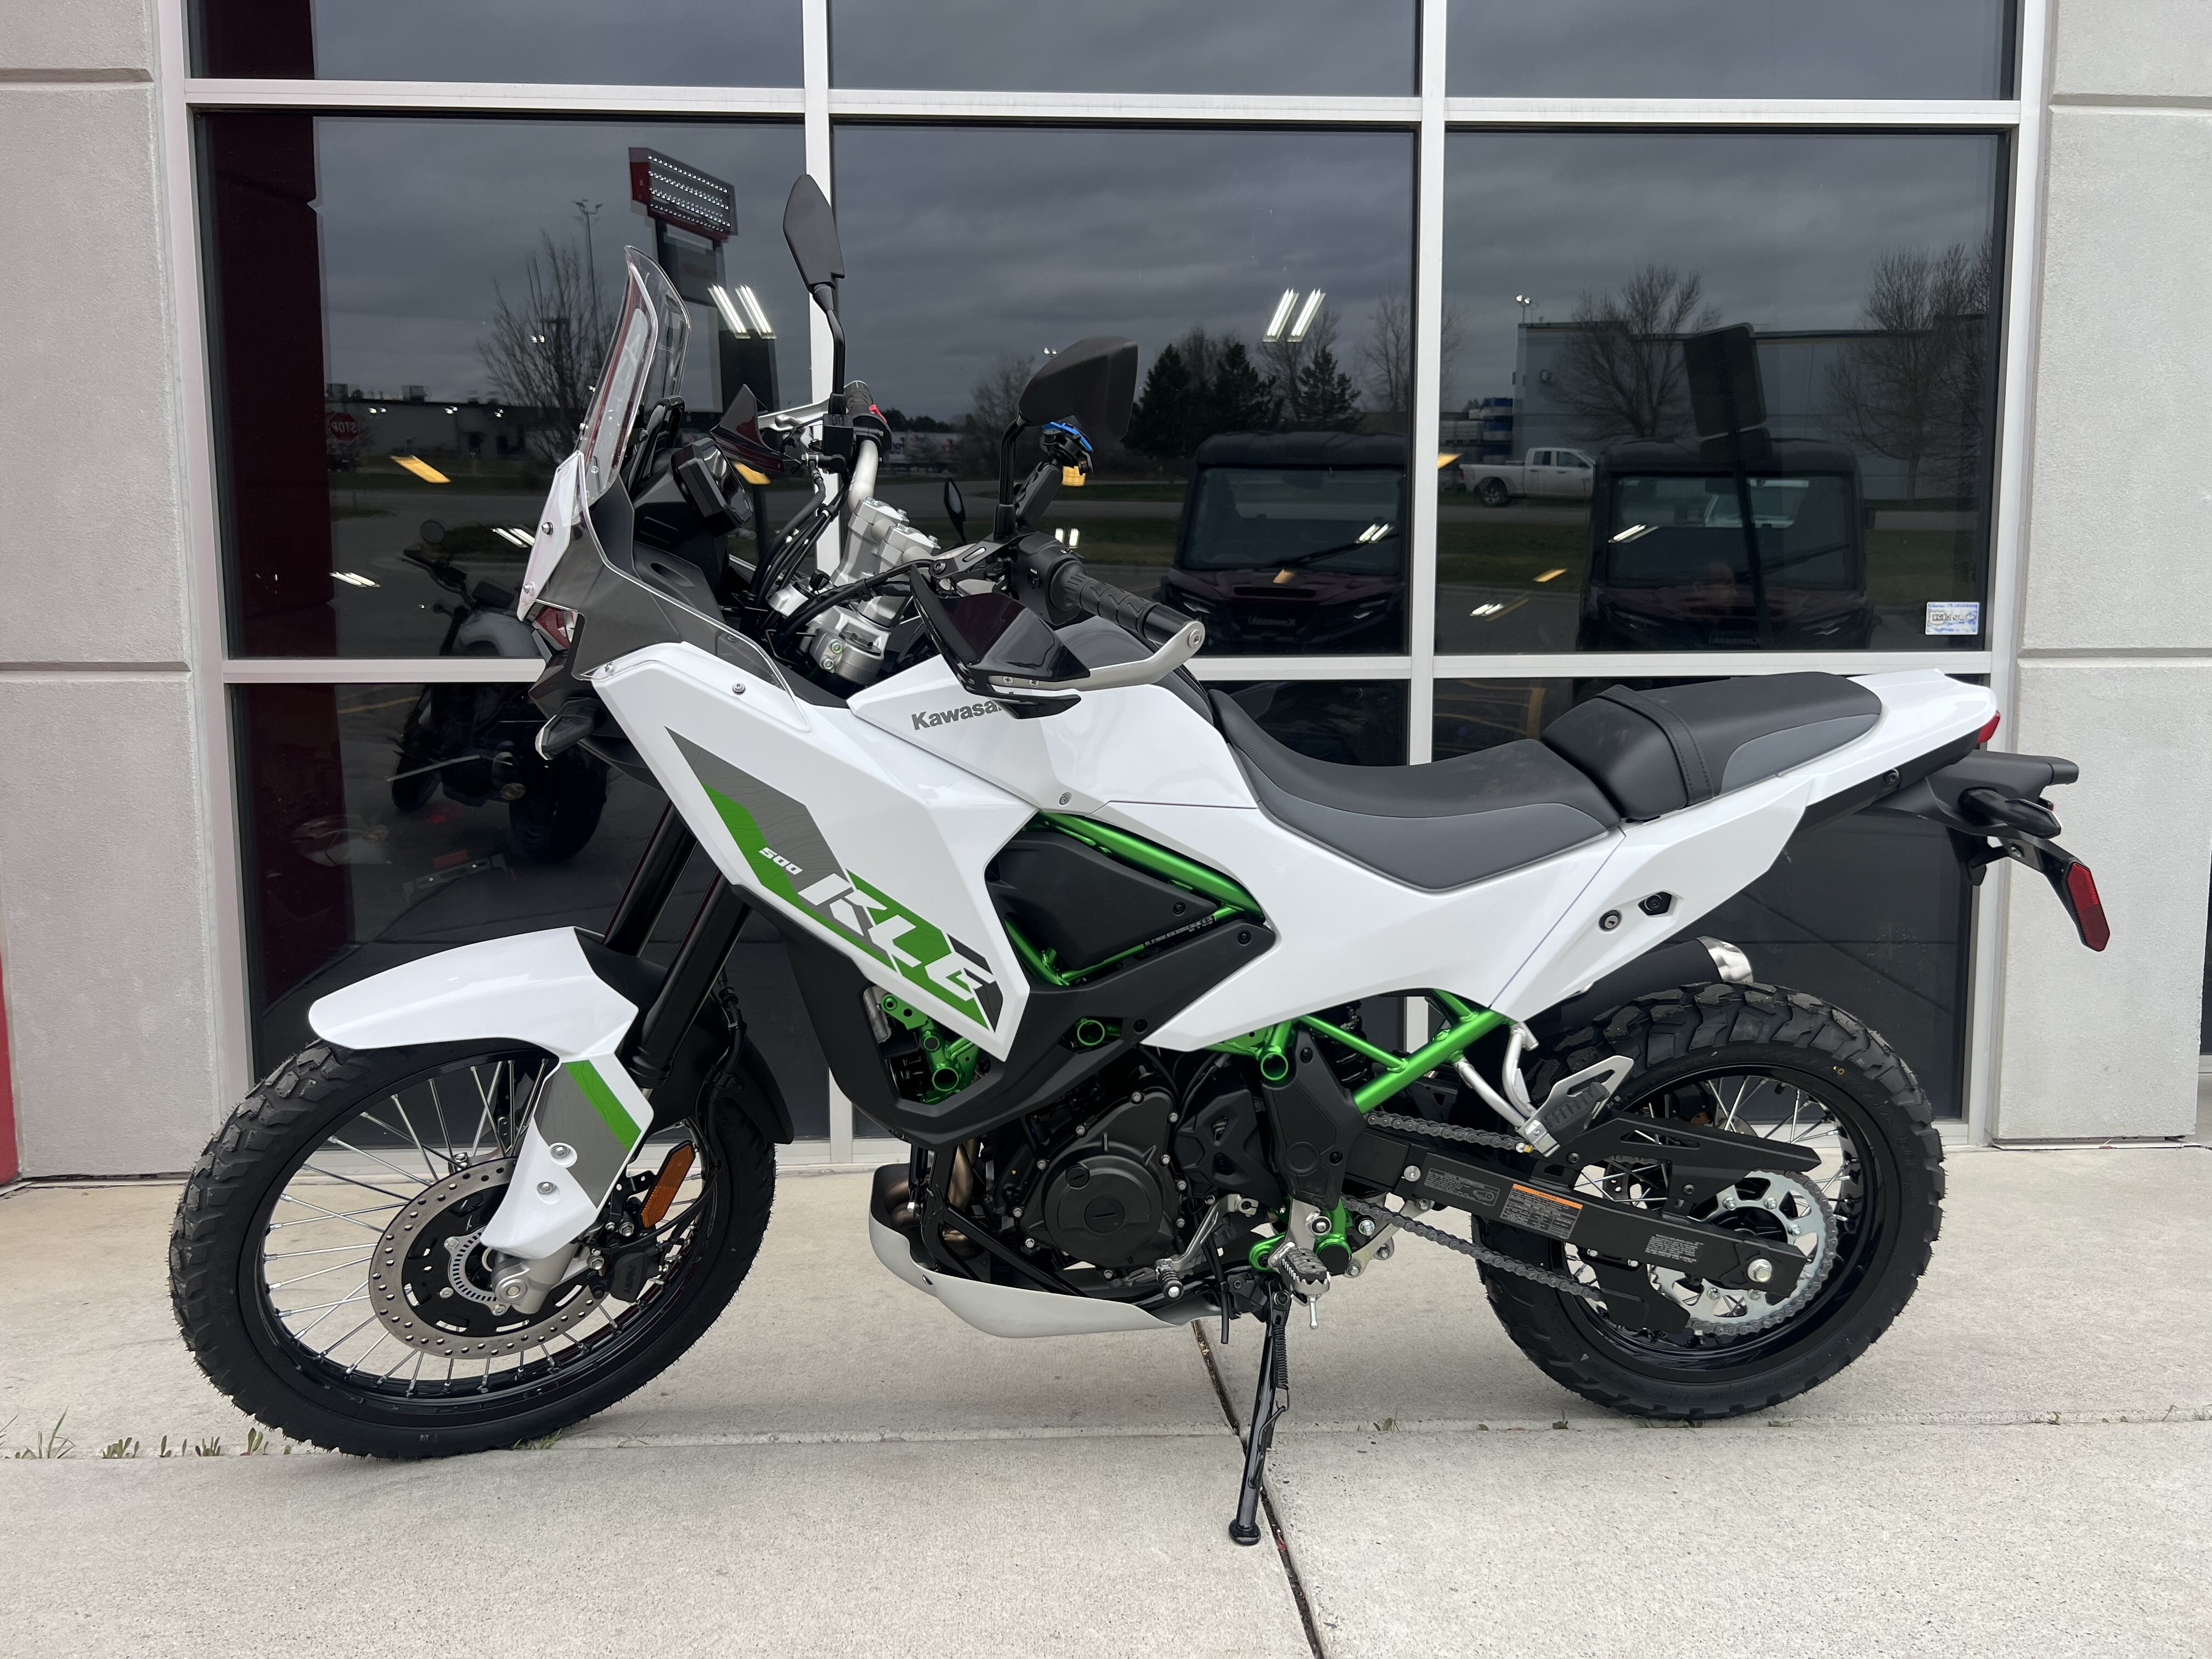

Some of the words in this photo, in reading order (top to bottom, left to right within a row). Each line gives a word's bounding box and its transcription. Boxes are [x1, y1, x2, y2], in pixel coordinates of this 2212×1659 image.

[911, 697, 1007, 731] Kawasa
[759, 847, 803, 875] 500
[798, 873, 997, 1001] KLE
